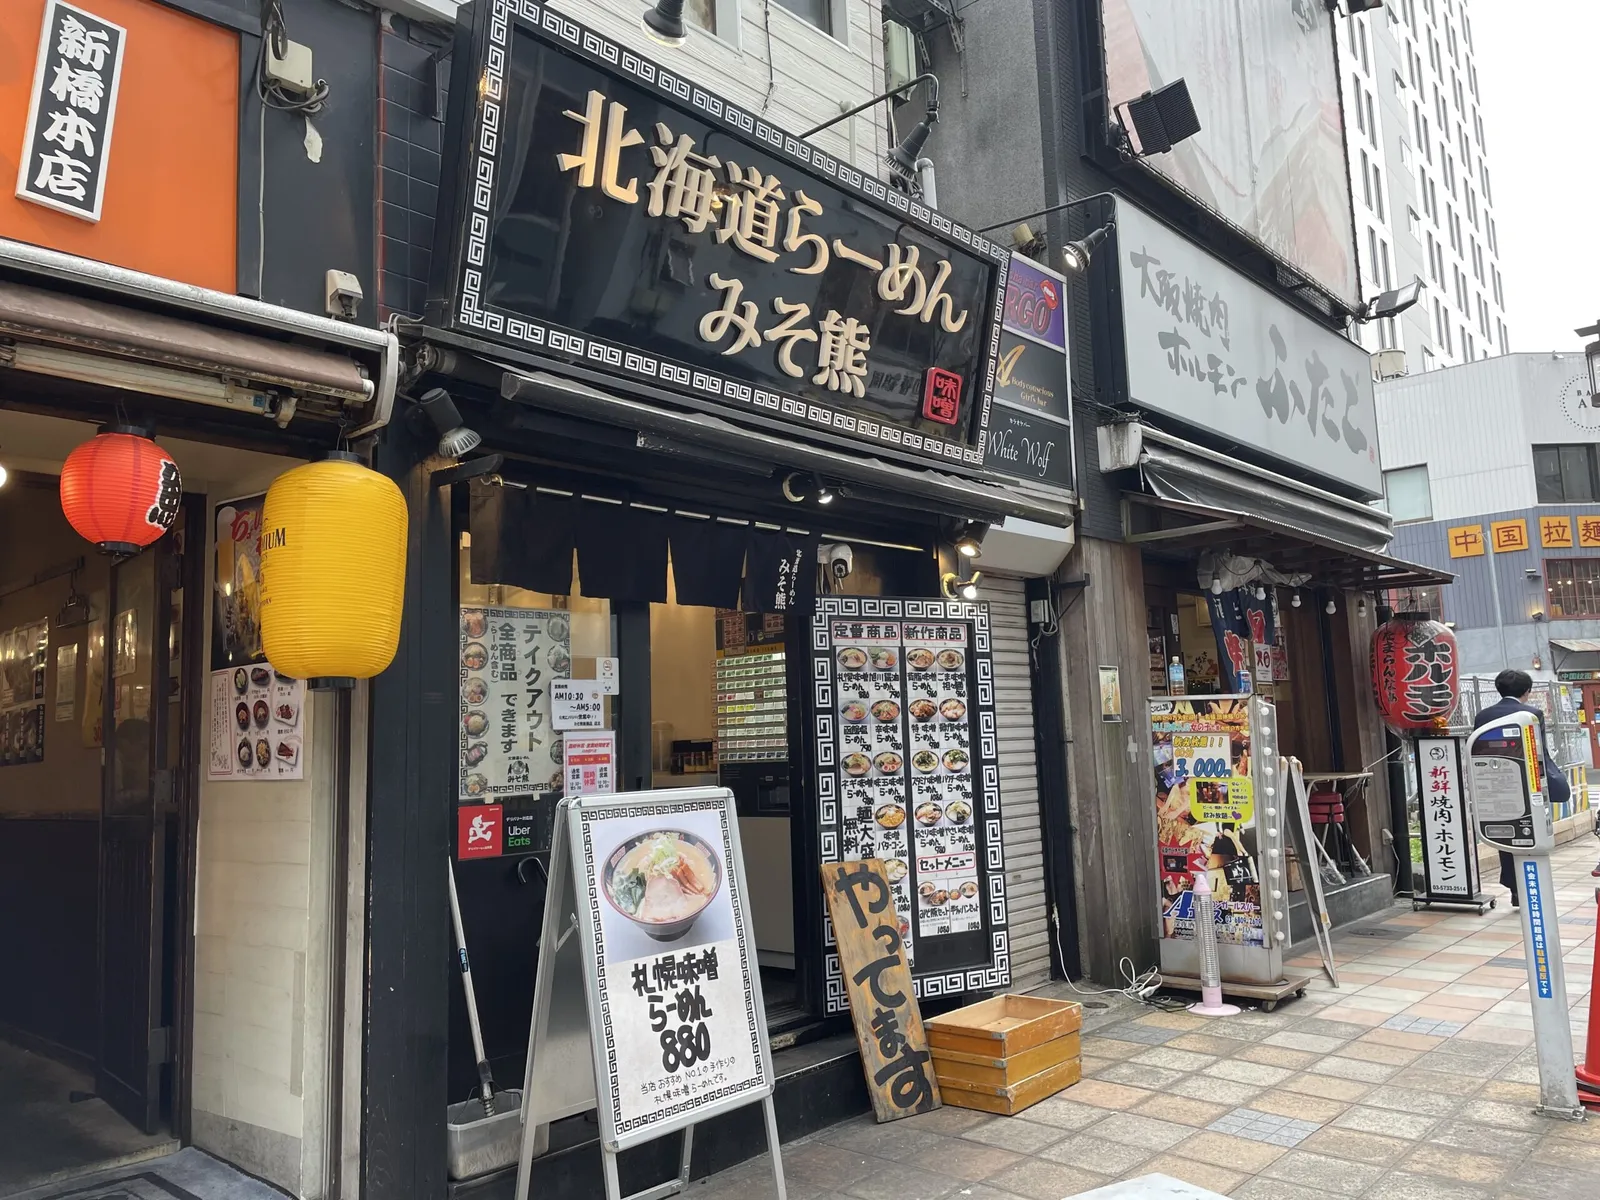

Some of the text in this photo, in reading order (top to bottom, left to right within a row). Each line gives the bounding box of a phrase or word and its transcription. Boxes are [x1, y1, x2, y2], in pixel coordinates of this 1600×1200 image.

[34, 14, 111, 201] 新橋本店
[556, 89, 968, 333] 北海道らーめん
[1130, 245, 1230, 352] 大阪焼肉
[700, 272, 870, 398] みそ熊
[1158, 327, 1248, 399] ホルモン
[931, 375, 957, 417] 味噌
[987, 429, 1055, 476] White Wolf
[774, 558, 791, 610] みそ熊
[834, 623, 897, 638] 定番商品
[904, 625, 962, 640] 新作商品
[837, 672, 869, 682] 札幌味噌
[1401, 639, 1453, 721] ホルモン
[498, 622, 519, 754] 全商品 できます
[522, 624, 544, 753] テイクアウト
[843, 682, 865, 691] らーめん
[874, 682, 896, 691] らーめん
[912, 682, 932, 690] らーめん
[554, 692, 584, 700] AM10:30
[845, 735, 866, 744] らーめん
[876, 734, 897, 743] らーめん
[841, 778, 873, 790] ネギ味噌
[879, 787, 900, 796] らーめん
[917, 785, 938, 794] らーめん
[947, 784, 967, 792] らーめん
[847, 789, 868, 798] らーめん
[508, 825, 531, 836] Uber
[843, 815, 860, 854] 無料
[857, 806, 875, 859] 麺大盛
[883, 831, 900, 840] 味噌
[508, 837, 531, 848] Eats
[920, 838, 941, 847] らーめん
[950, 835, 970, 845] らーめん
[919, 856, 973, 871] セットメニュー
[1432, 884, 1467, 893] 03-5733-2514
[631, 947, 719, 997] 札幌味噌
[835, 863, 933, 1112] やってます
[647, 985, 713, 1032] らーめん
[660, 1021, 711, 1073] 880
[640, 1082, 656, 1095] 当店
[658, 1073, 682, 1090] おすすめ
